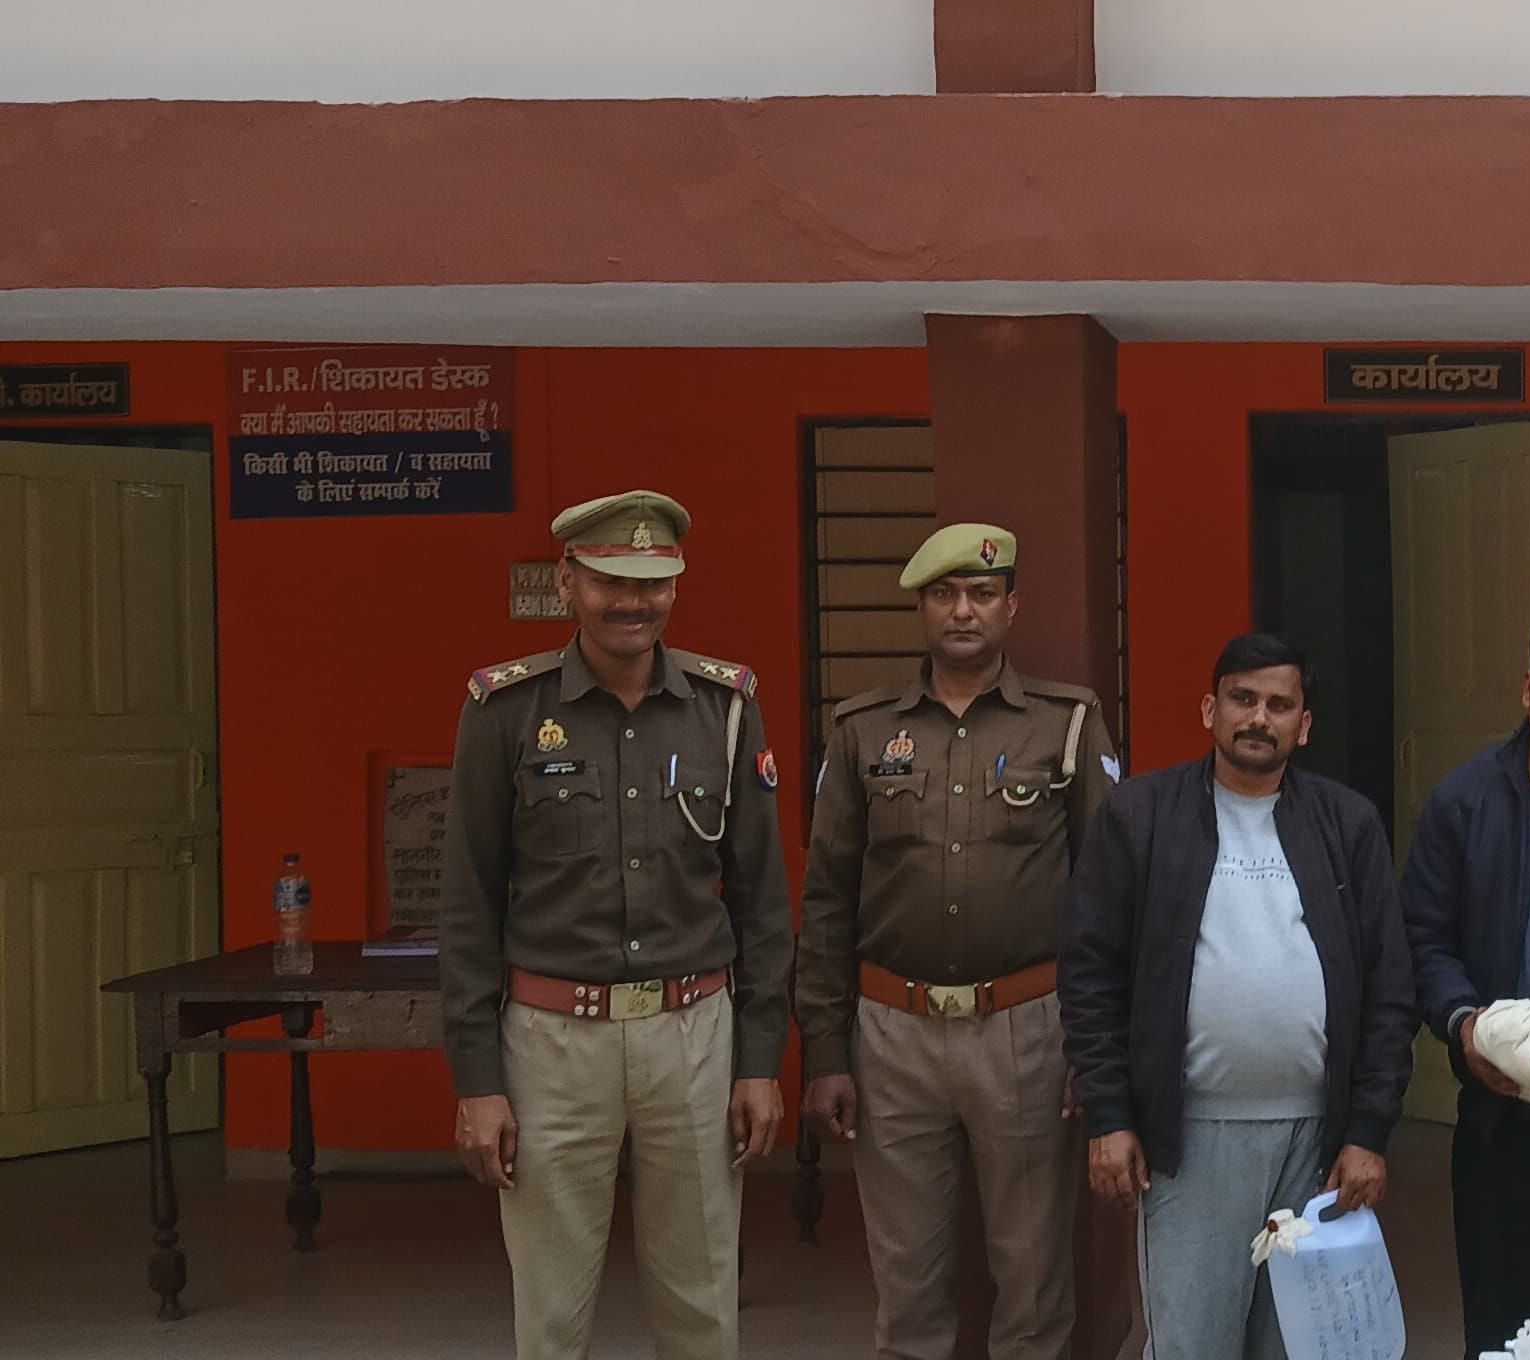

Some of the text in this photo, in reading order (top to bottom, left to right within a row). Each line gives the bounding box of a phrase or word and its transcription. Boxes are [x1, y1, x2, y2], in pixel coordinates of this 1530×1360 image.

[20, 371, 118, 409] कार्यालय
[430, 357, 490, 391] डेस्क
[1352, 355, 1501, 391] कार्यालय
[240, 410, 269, 436] क्या
[271, 402, 286, 435] मैं
[287, 401, 335, 435] आपकी
[339, 407, 396, 435] सहायता
[399, 408, 422, 433] कर
[425, 406, 471, 432] सकता
[243, 452, 289, 476] किसी
[294, 452, 312, 475] भी
[318, 451, 388, 475] शिकायत
[410, 452, 421, 473] व
[428, 451, 493, 472] सहायता
[296, 482, 313, 503] के
[358, 479, 409, 502] सम्पर्क
[414, 477, 442, 501] करें
